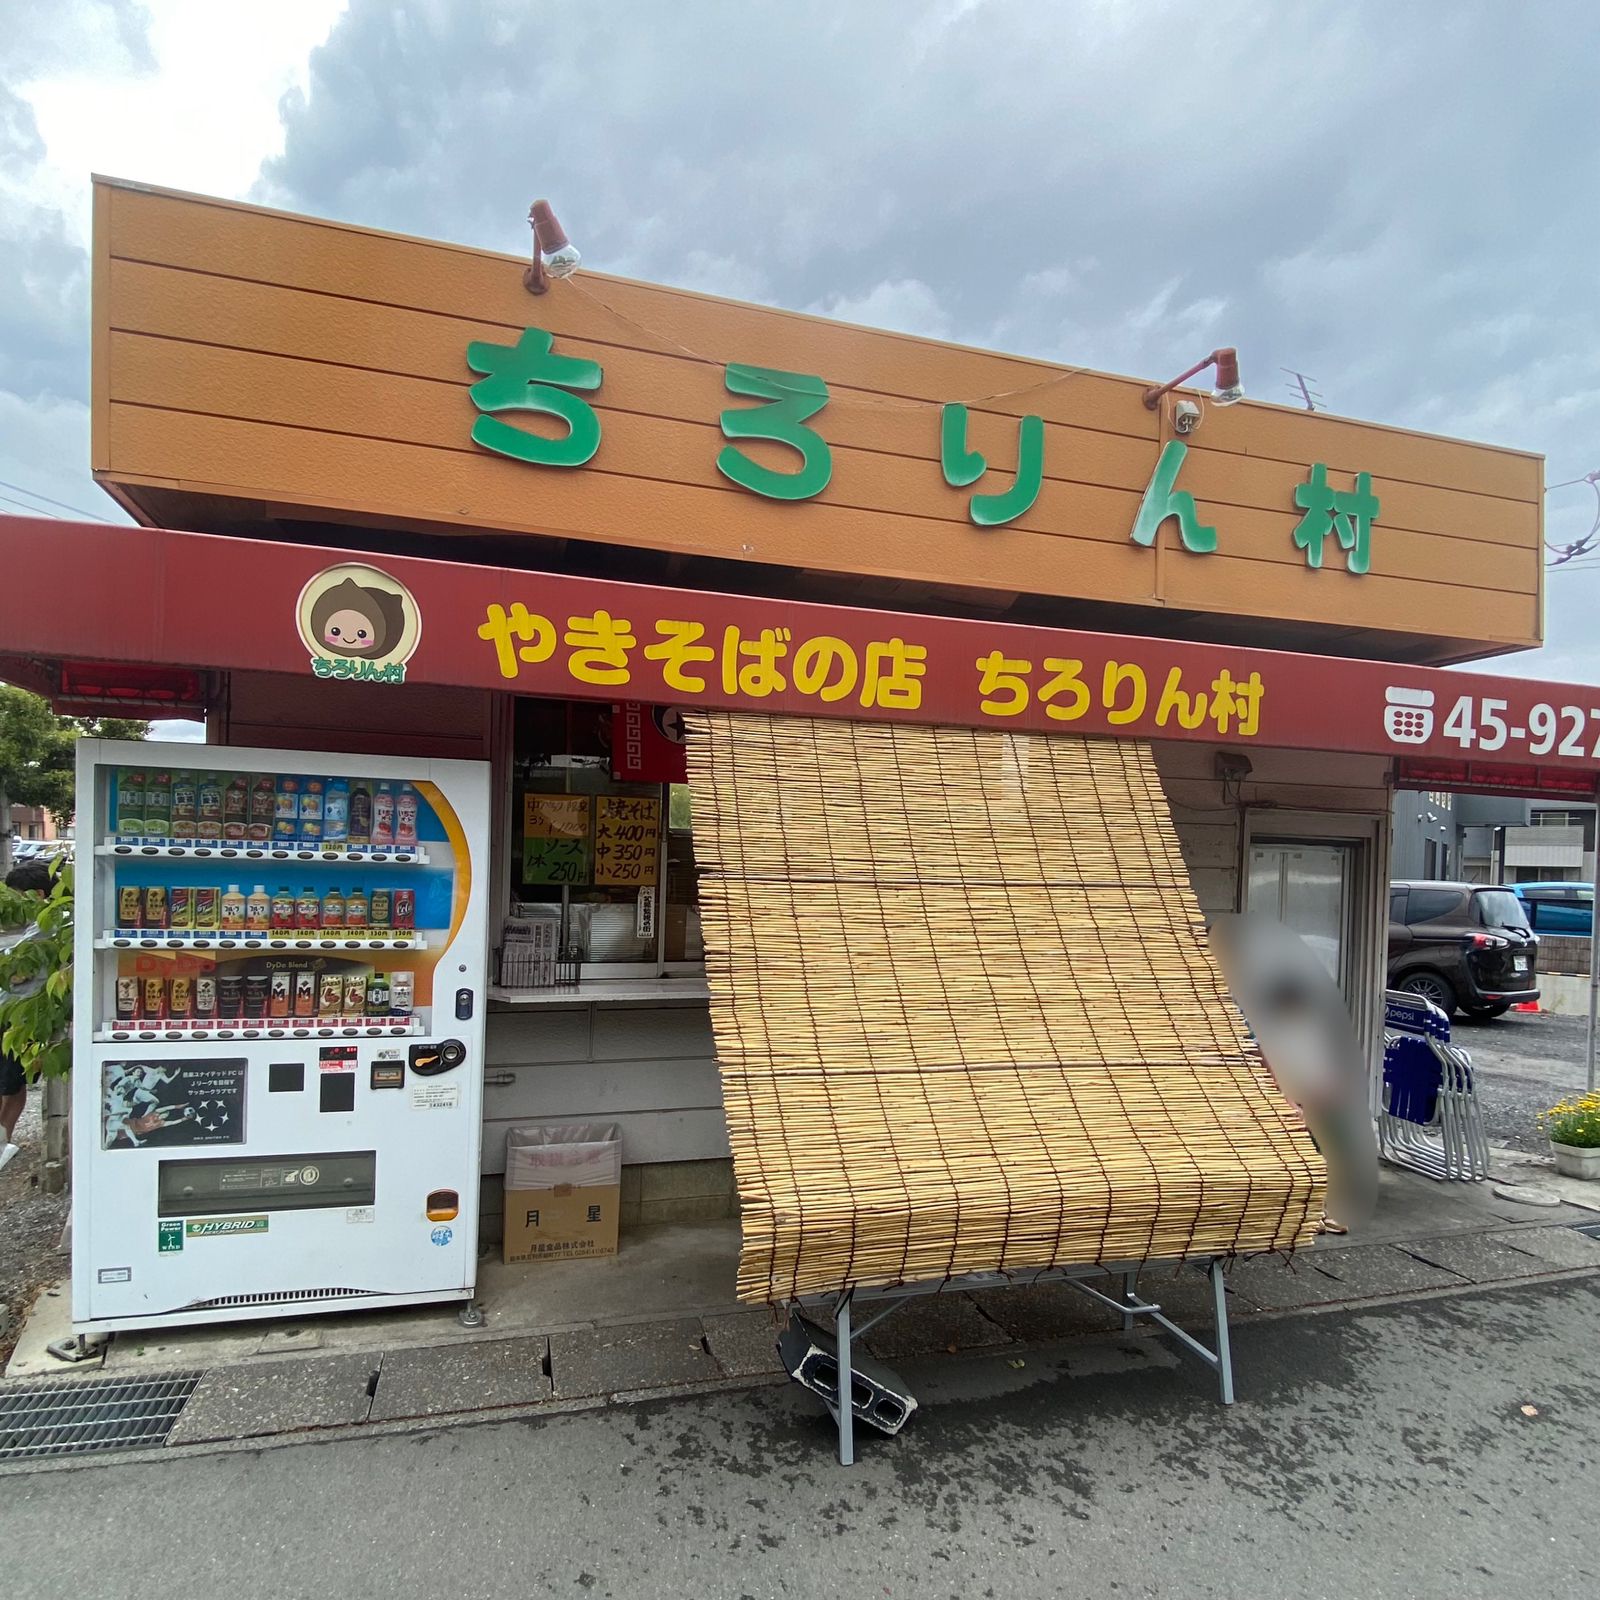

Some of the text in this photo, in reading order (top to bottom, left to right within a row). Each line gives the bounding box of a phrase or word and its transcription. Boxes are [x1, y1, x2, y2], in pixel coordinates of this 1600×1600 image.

[466, 326, 1380, 574] ちろりん村
[312, 656, 405, 683] ちろりん村
[477, 601, 1264, 736] やきそばの店 ちろりん村
[600, 798, 656, 821] 焼そば
[545, 838, 584, 855] ソース
[288, 961, 308, 969] Blend
[1390, 1010, 1414, 1021] pepsi
[200, 1220, 256, 1234] HYBRID
[525, 1205, 601, 1228] 月 星
